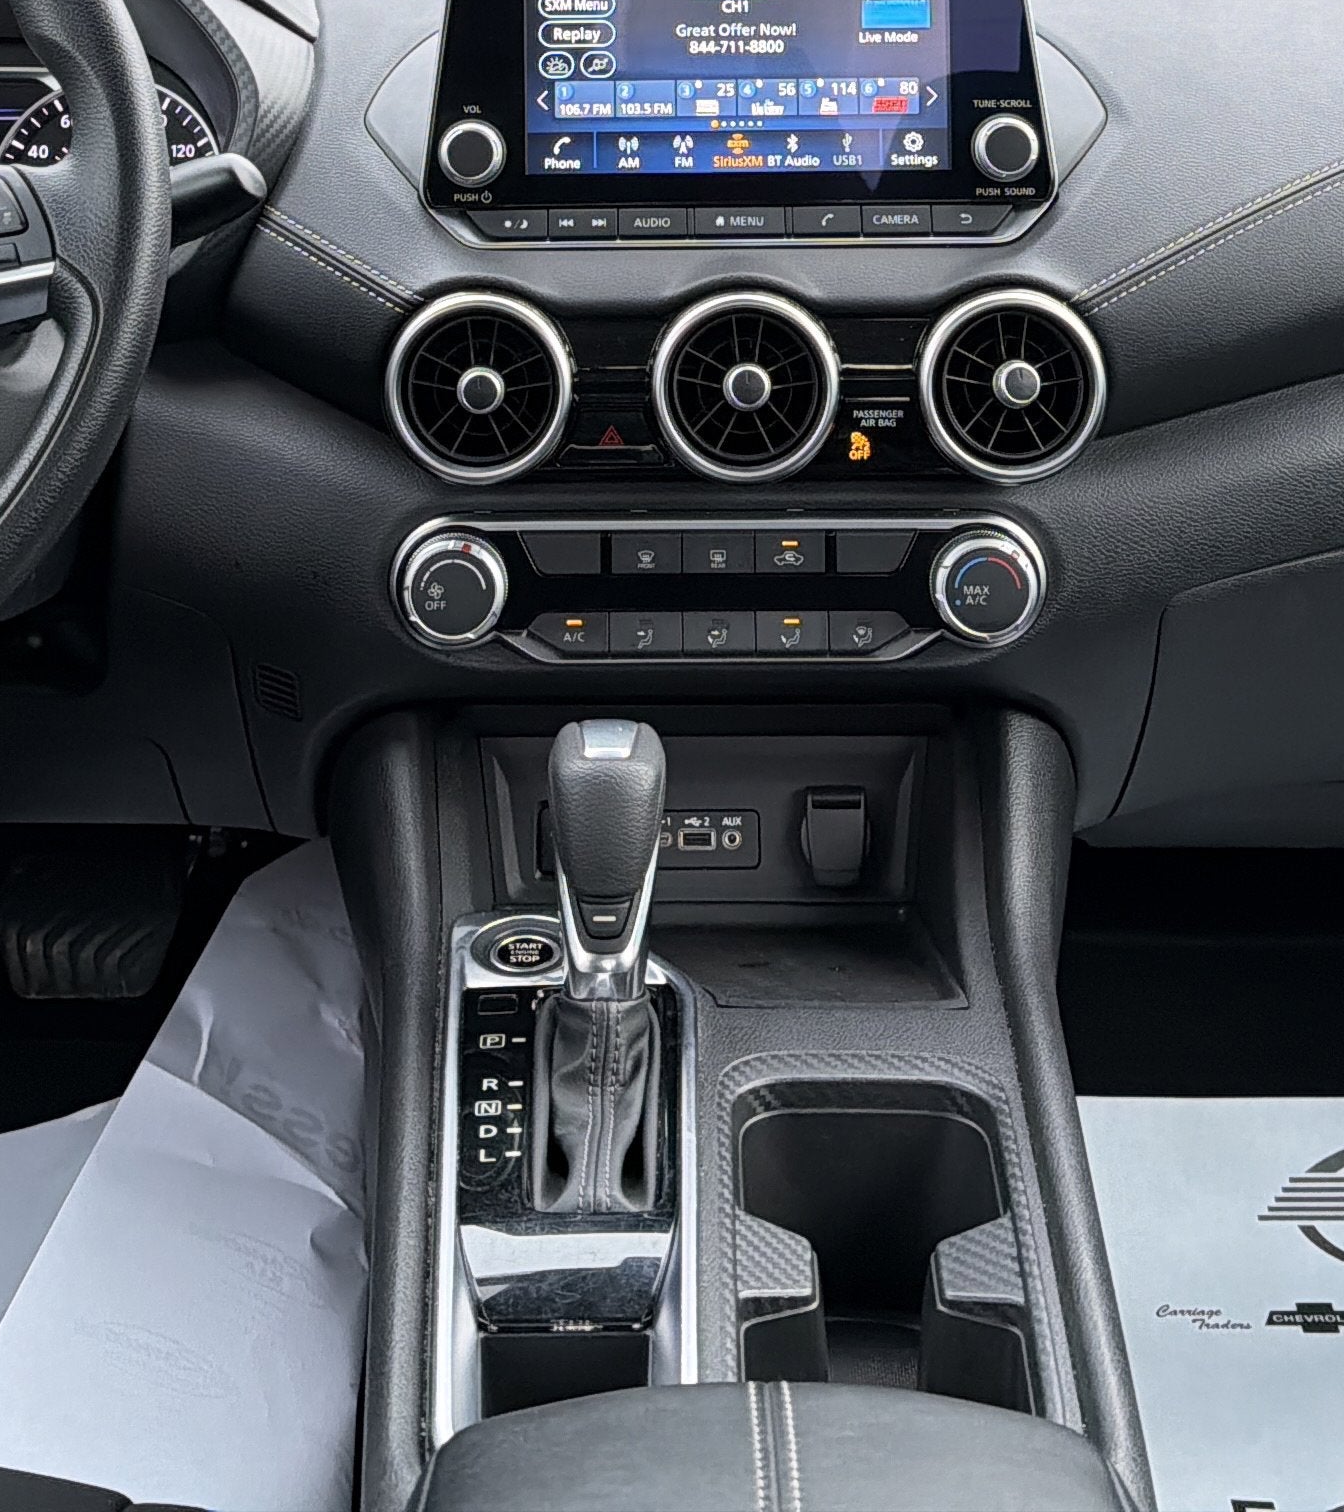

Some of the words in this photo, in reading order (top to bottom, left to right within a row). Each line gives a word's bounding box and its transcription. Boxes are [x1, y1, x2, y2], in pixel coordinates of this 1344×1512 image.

[721, 0, 749, 13] CH1
[553, 27, 601, 43] Replay
[676, 23, 715, 37] Great
[718, 23, 757, 37] Offer
[760, 22, 797, 36] Now!
[858, 31, 883, 43] Live
[885, 31, 919, 43] Mode
[689, 40, 785, 54] 844-711-8800
[560, 87, 568, 97] 1
[621, 86, 629, 97] 2
[682, 85, 690, 97] 3
[716, 83, 736, 97] 25
[743, 84, 752, 95] 4
[778, 82, 796, 96] 56
[805, 84, 812, 95] 5
[831, 82, 857, 96] 114
[864, 83, 873, 94] 6
[899, 81, 919, 95] 80
[463, 105, 482, 114] VOL
[559, 103, 589, 116] 106.7
[592, 103, 612, 115] FM
[620, 103, 652, 115] 103.5
[653, 103, 673, 115] FM
[60, 114, 73, 129] 6
[27, 144, 50, 159] 40
[171, 144, 196, 159] 120
[544, 157, 581, 170] Phone
[618, 157, 640, 169] AM
[674, 156, 694, 168] FM
[713, 155, 763, 168] SiriusXM
[767, 155, 782, 167] BT
[785, 155, 820, 167] Audio
[832, 154, 863, 166] USB1
[890, 153, 939, 168] Settings
[453, 193, 479, 202] PUSH
[975, 187, 1001, 197] PUSH
[1004, 187, 1036, 196] SOUND
[633, 217, 671, 228] AUDIO
[730, 215, 765, 227] MENU
[872, 214, 920, 225] CAMERA
[852, 409, 905, 419] PASSENGER
[859, 418, 876, 427] AIR
[877, 418, 897, 427] BAG
[848, 449, 871, 461] OFF
[963, 585, 991, 595] MAX
[424, 600, 447, 611] OFF
[965, 595, 988, 605] A/C
[563, 631, 585, 643] A/C
[722, 816, 742, 826] AUX
[508, 942, 544, 950] START
[509, 955, 541, 963] STOP
[486, 1036, 500, 1047] P
[482, 1078, 499, 1091] R
[480, 1102, 496, 1114] N
[479, 1124, 498, 1139] D
[479, 1148, 497, 1163] L
[1156, 1303, 1223, 1320] Carriage
[1191, 1318, 1253, 1330] Traders
